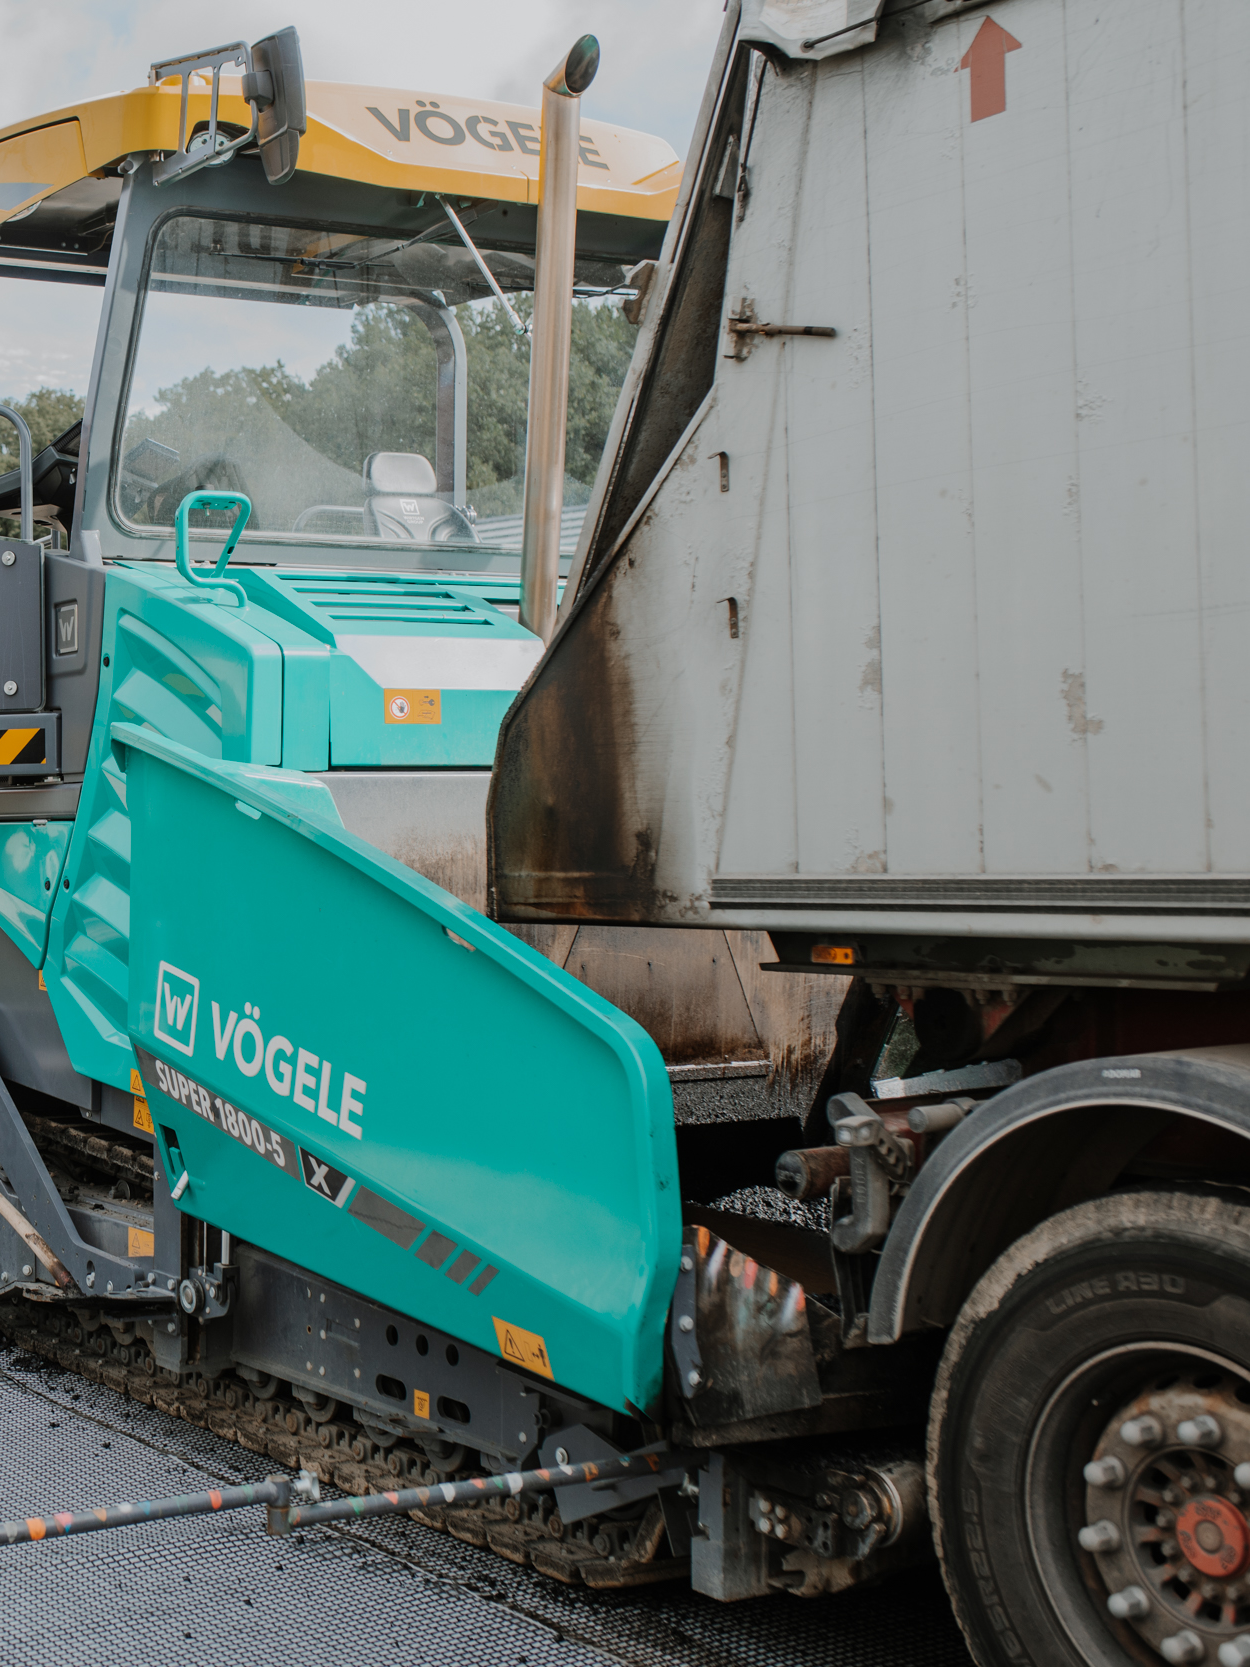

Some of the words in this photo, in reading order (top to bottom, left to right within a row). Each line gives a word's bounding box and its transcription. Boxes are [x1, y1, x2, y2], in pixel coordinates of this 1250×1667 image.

[364, 99, 611, 171] VÖGEE
[210, 1001, 368, 1140] VÖGELE
[154, 1059, 216, 1122] SUPER
[214, 1097, 286, 1168] 1800-5
[309, 1154, 333, 1196] X
[1044, 1274, 1112, 1315] LINE
